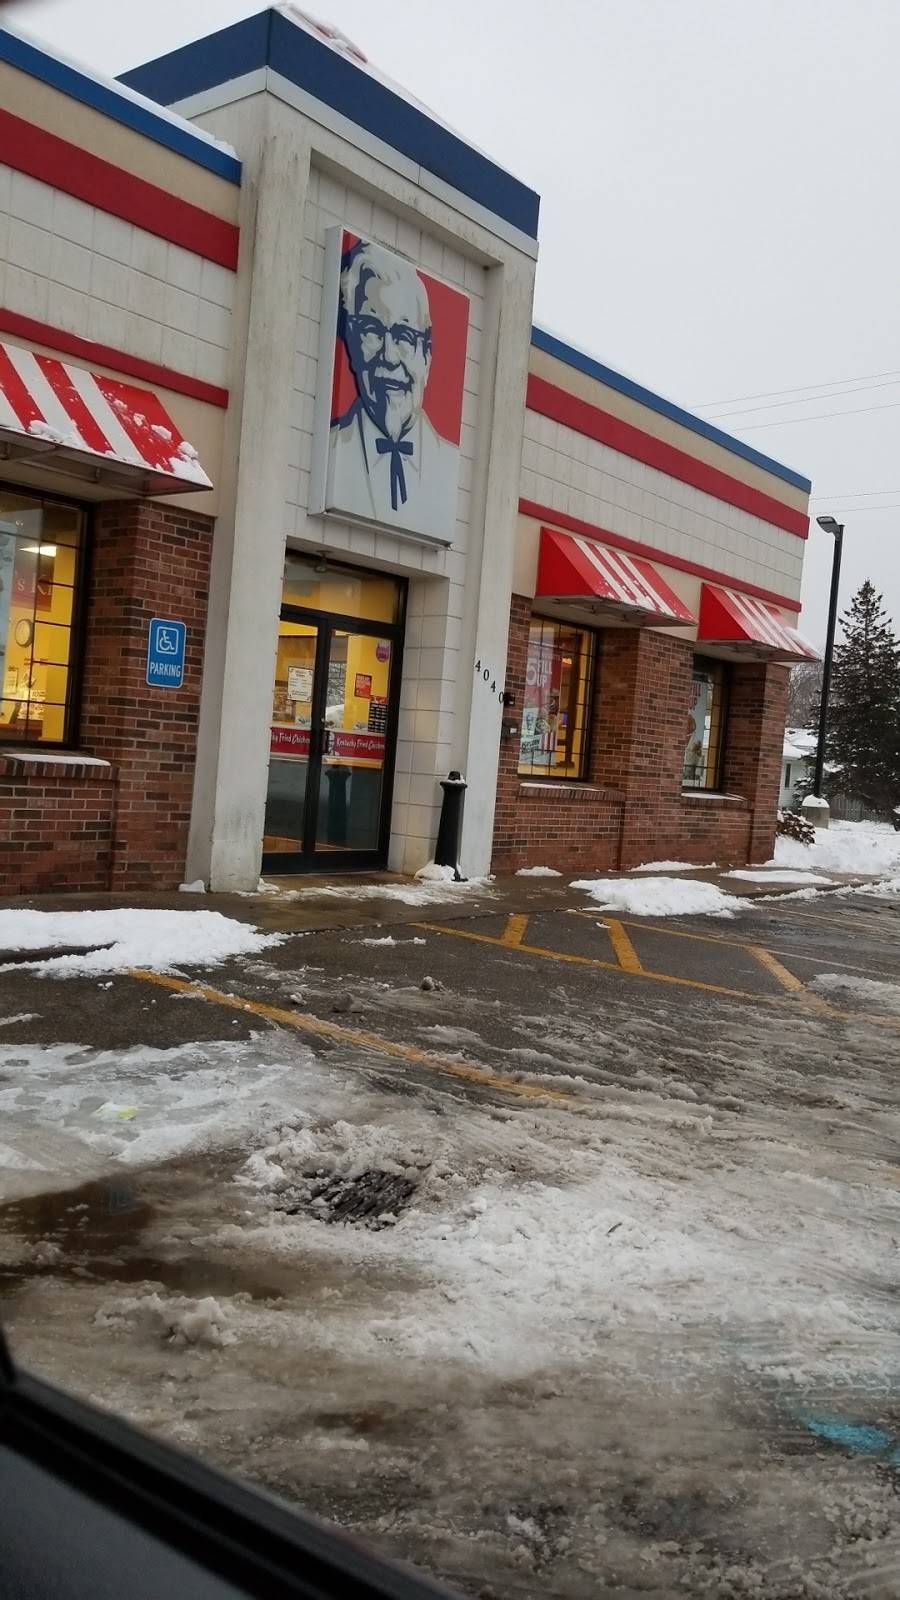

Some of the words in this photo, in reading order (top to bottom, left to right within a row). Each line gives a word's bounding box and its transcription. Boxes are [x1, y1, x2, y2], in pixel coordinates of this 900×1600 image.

[149, 662, 181, 678] PARKING
[474, 659, 504, 704] 4040
[279, 732, 292, 744] Fried
[336, 737, 356, 749] Kentucky
[356, 738, 369, 749] Fried
